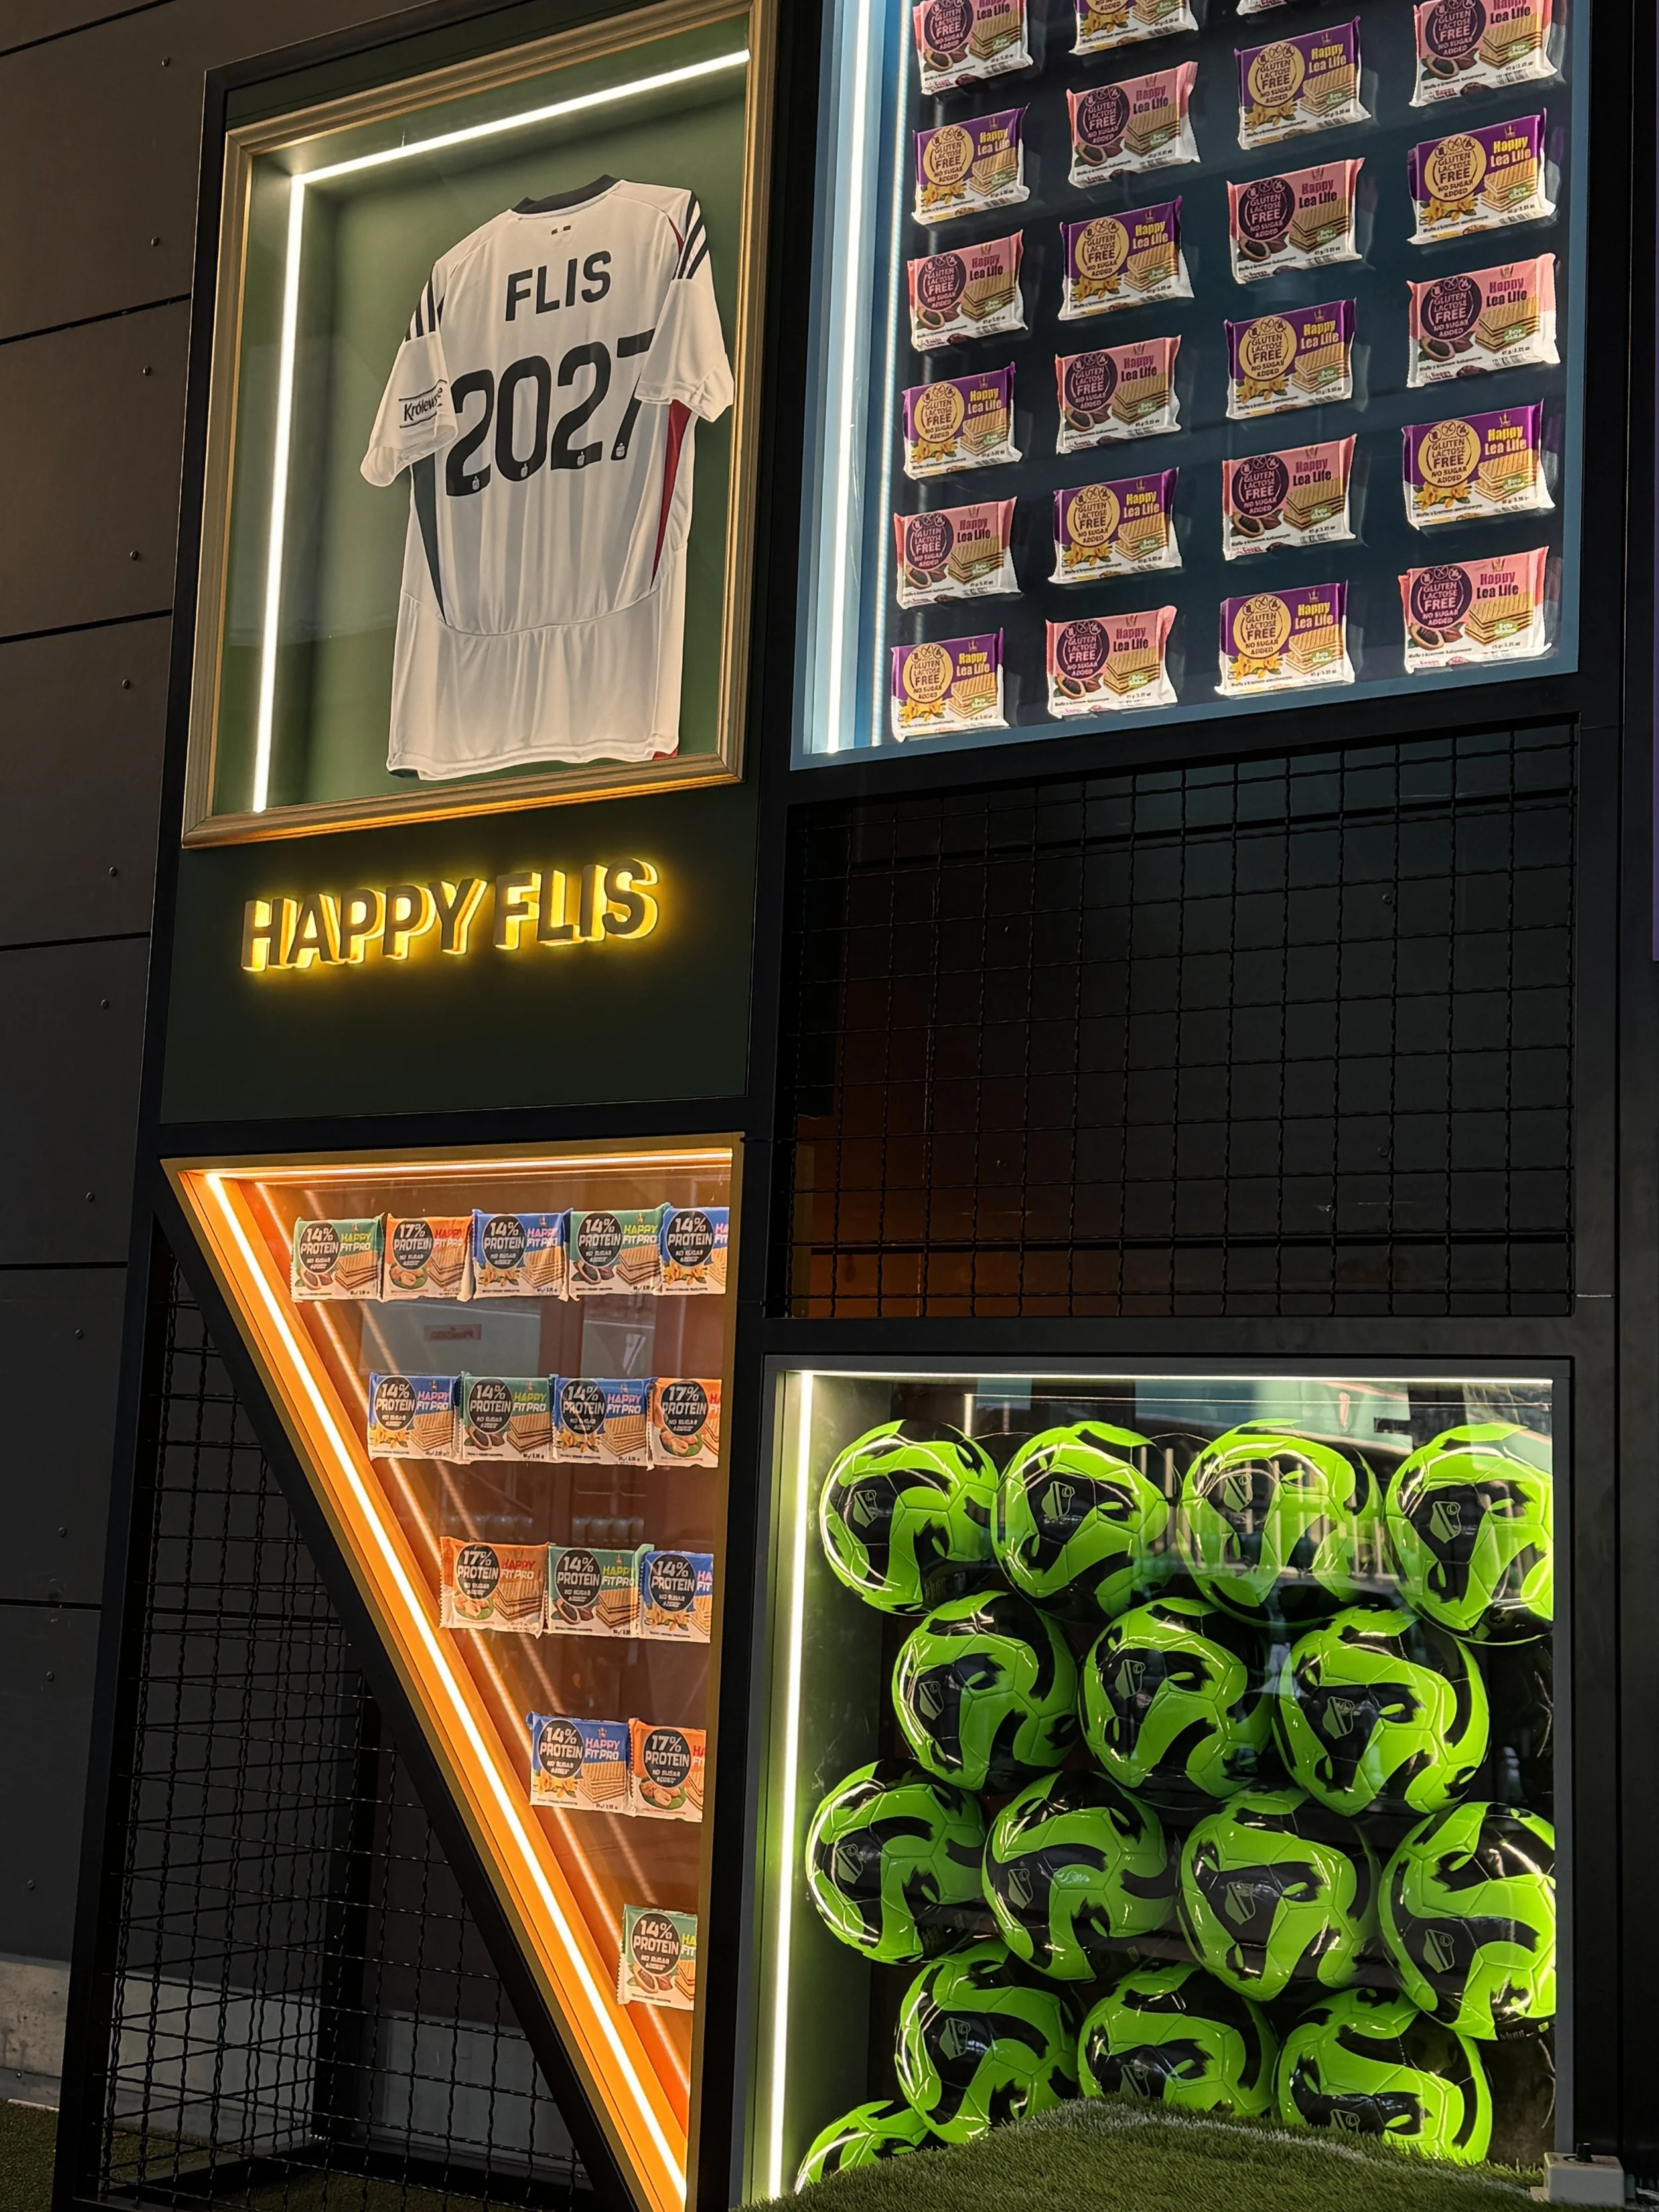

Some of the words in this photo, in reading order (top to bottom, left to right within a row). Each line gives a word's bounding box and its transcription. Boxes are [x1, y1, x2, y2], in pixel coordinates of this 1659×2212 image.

[936, 21, 962, 38] FREE
[1439, 24, 1471, 42] FREE
[1311, 42, 1344, 60] Happy
[1262, 74, 1290, 90] FREE
[1135, 85, 1166, 102] Happy
[1089, 114, 1117, 131] FREE
[1494, 136, 1528, 153] Happy
[936, 155, 961, 170] FREE
[1440, 167, 1471, 184] FREE
[1301, 178, 1334, 195] Happy
[1252, 208, 1281, 224] FREE
[1135, 221, 1166, 236] Happy
[1088, 248, 1115, 263] FREE
[505, 250, 611, 321] FLIS
[928, 280, 954, 296] FREE
[1490, 277, 1524, 294] Happy
[1435, 307, 1467, 324] FREE
[1303, 321, 1336, 336] Happy
[1123, 354, 1154, 369] Happy
[1254, 348, 1282, 364] FREE
[1077, 381, 1104, 396] FREE
[446, 328, 656, 496] 2027
[926, 413, 952, 427] FREE
[1488, 426, 1523, 441] Happy
[1432, 439, 1465, 451] GLUTEN
[1295, 458, 1328, 473] Happy
[1433, 454, 1465, 469] FREE
[1437, 475, 1462, 484] ADDED
[1126, 491, 1157, 505] Happy
[1245, 485, 1275, 500] FREE
[1080, 516, 1106, 530] FREE
[916, 541, 941, 554] FREE
[1480, 571, 1516, 585] Happy
[1423, 582, 1457, 593] GLUTEN
[1297, 603, 1330, 616] Happy
[1425, 597, 1457, 611] FREE
[1246, 613, 1277, 623] GLUTEN
[1428, 617, 1453, 626] ADDED
[1116, 627, 1146, 640] Happy
[1247, 627, 1276, 640] FREE
[1069, 650, 1096, 663] FREE
[915, 674, 940, 686] FREE
[241, 877, 486, 971] HAPPY
[492, 858, 658, 950] FLIS
[399, 1222, 426, 1238] 17%
[489, 1221, 519, 1236] 14%
[585, 1218, 615, 1234] 14%
[623, 1224, 657, 1234] HAPPY
[674, 1217, 706, 1233] 14%
[306, 1227, 333, 1242] 14%
[579, 1234, 621, 1247] PROTEIN
[668, 1232, 713, 1246] PROTEIN
[301, 1242, 339, 1255] PROTEIN
[394, 1237, 432, 1252] PROTEIN
[484, 1236, 525, 1250] PROTEIN
[382, 1383, 409, 1398] 14%
[417, 1391, 449, 1400] HAPPY
[476, 1385, 506, 1400] 14%
[514, 1392, 547, 1402] HAPPY
[567, 1386, 599, 1401] 14%
[667, 1386, 700, 1402] 17%
[376, 1398, 415, 1411] PROTEIN
[470, 1400, 512, 1412] PROTEIN
[607, 1394, 640, 1404] HAPPY
[562, 1402, 605, 1414] PROTEIN
[662, 1402, 707, 1415] PROTEIN
[463, 1550, 492, 1566] 17%
[500, 1559, 534, 1569] HAPPY
[563, 1556, 594, 1572] 14%
[457, 1566, 498, 1580] PROTEIN
[656, 1560, 688, 1578] 14%
[557, 1572, 601, 1586] PROTEIN
[651, 1576, 695, 1591] PROTEIN
[545, 1726, 577, 1744] 14%
[585, 1737, 620, 1749] HAPPY
[650, 1734, 683, 1752] 17%
[540, 1743, 583, 1759] PROTEIN
[644, 1751, 689, 1767] PROTEIN
[640, 1919, 672, 1940] 14%
[634, 1935, 680, 1955] PROTEIN
